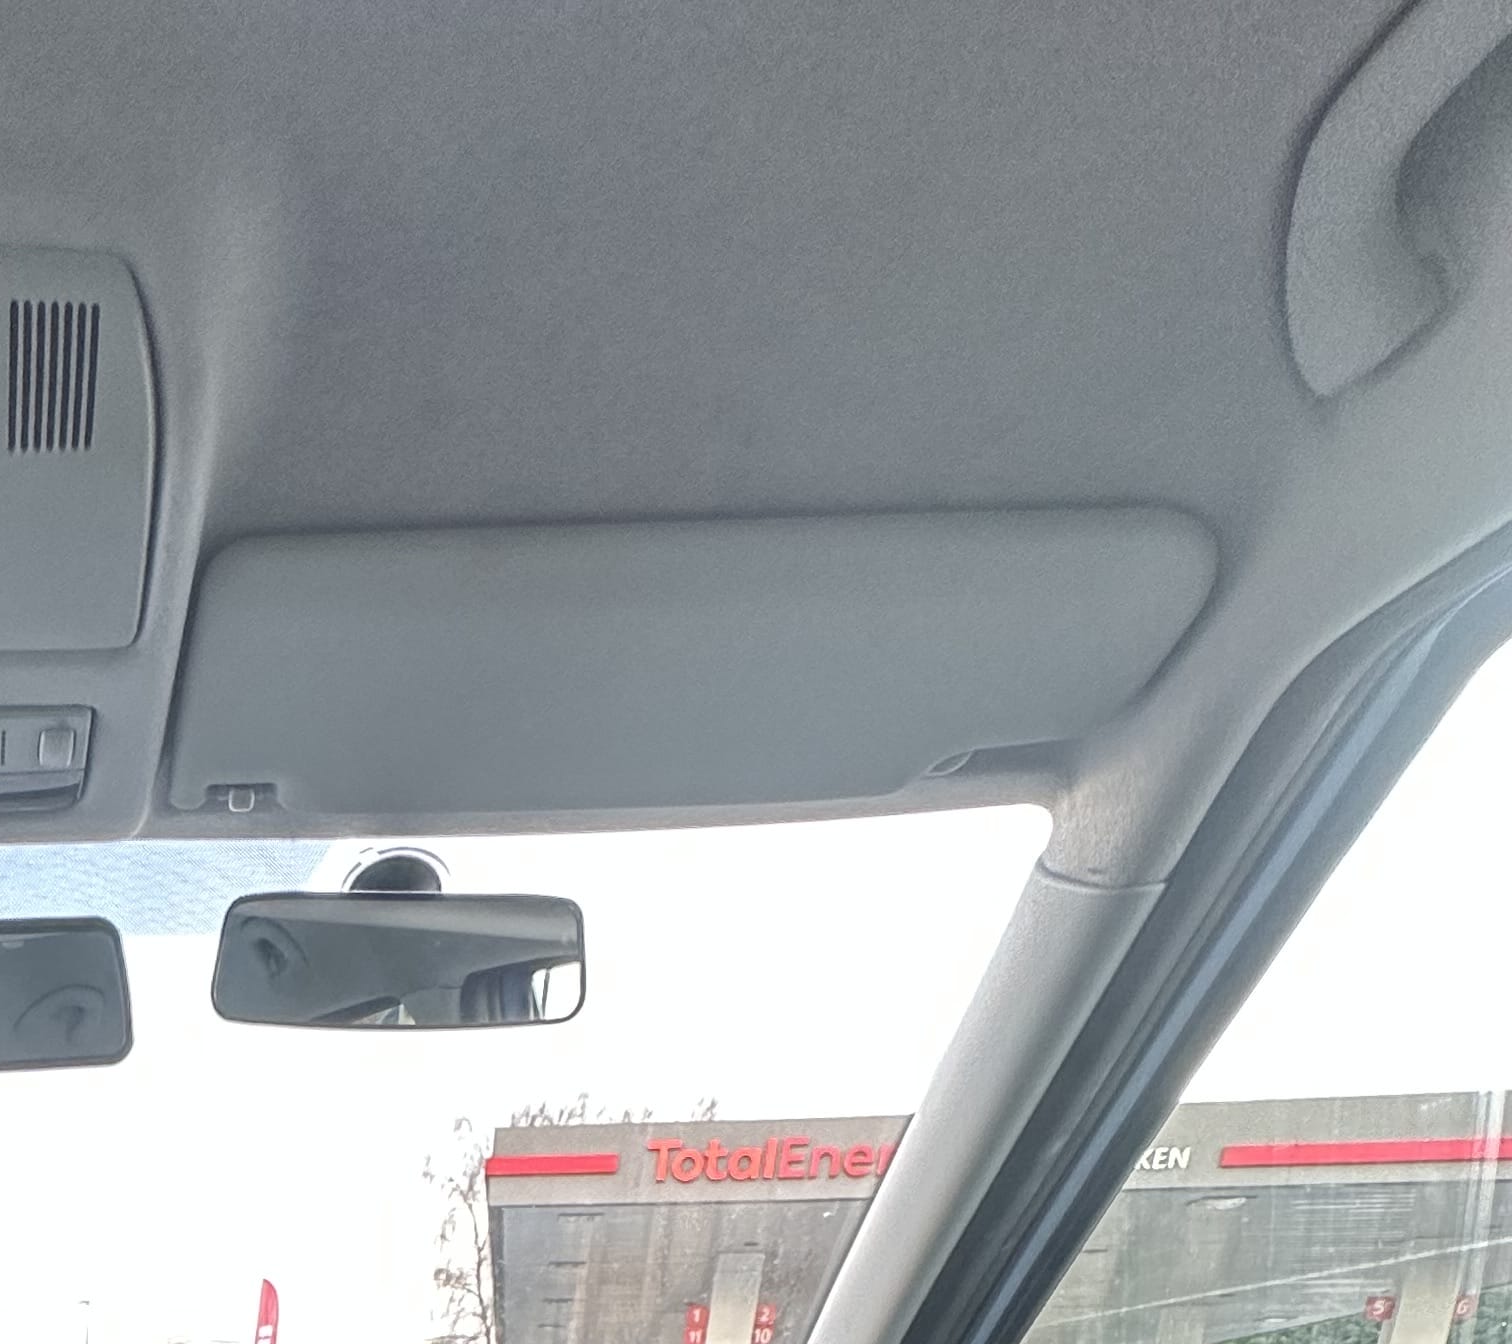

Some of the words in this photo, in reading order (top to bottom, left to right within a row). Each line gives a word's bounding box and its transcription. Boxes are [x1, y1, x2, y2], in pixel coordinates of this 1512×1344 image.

[759, 1307, 770, 1323] 2
[1372, 1299, 1385, 1316] 5
[1456, 1299, 1469, 1315] 6
[692, 1308, 702, 1323] 1
[688, 1330, 702, 1343] 11
[754, 1327, 771, 1344] 10
